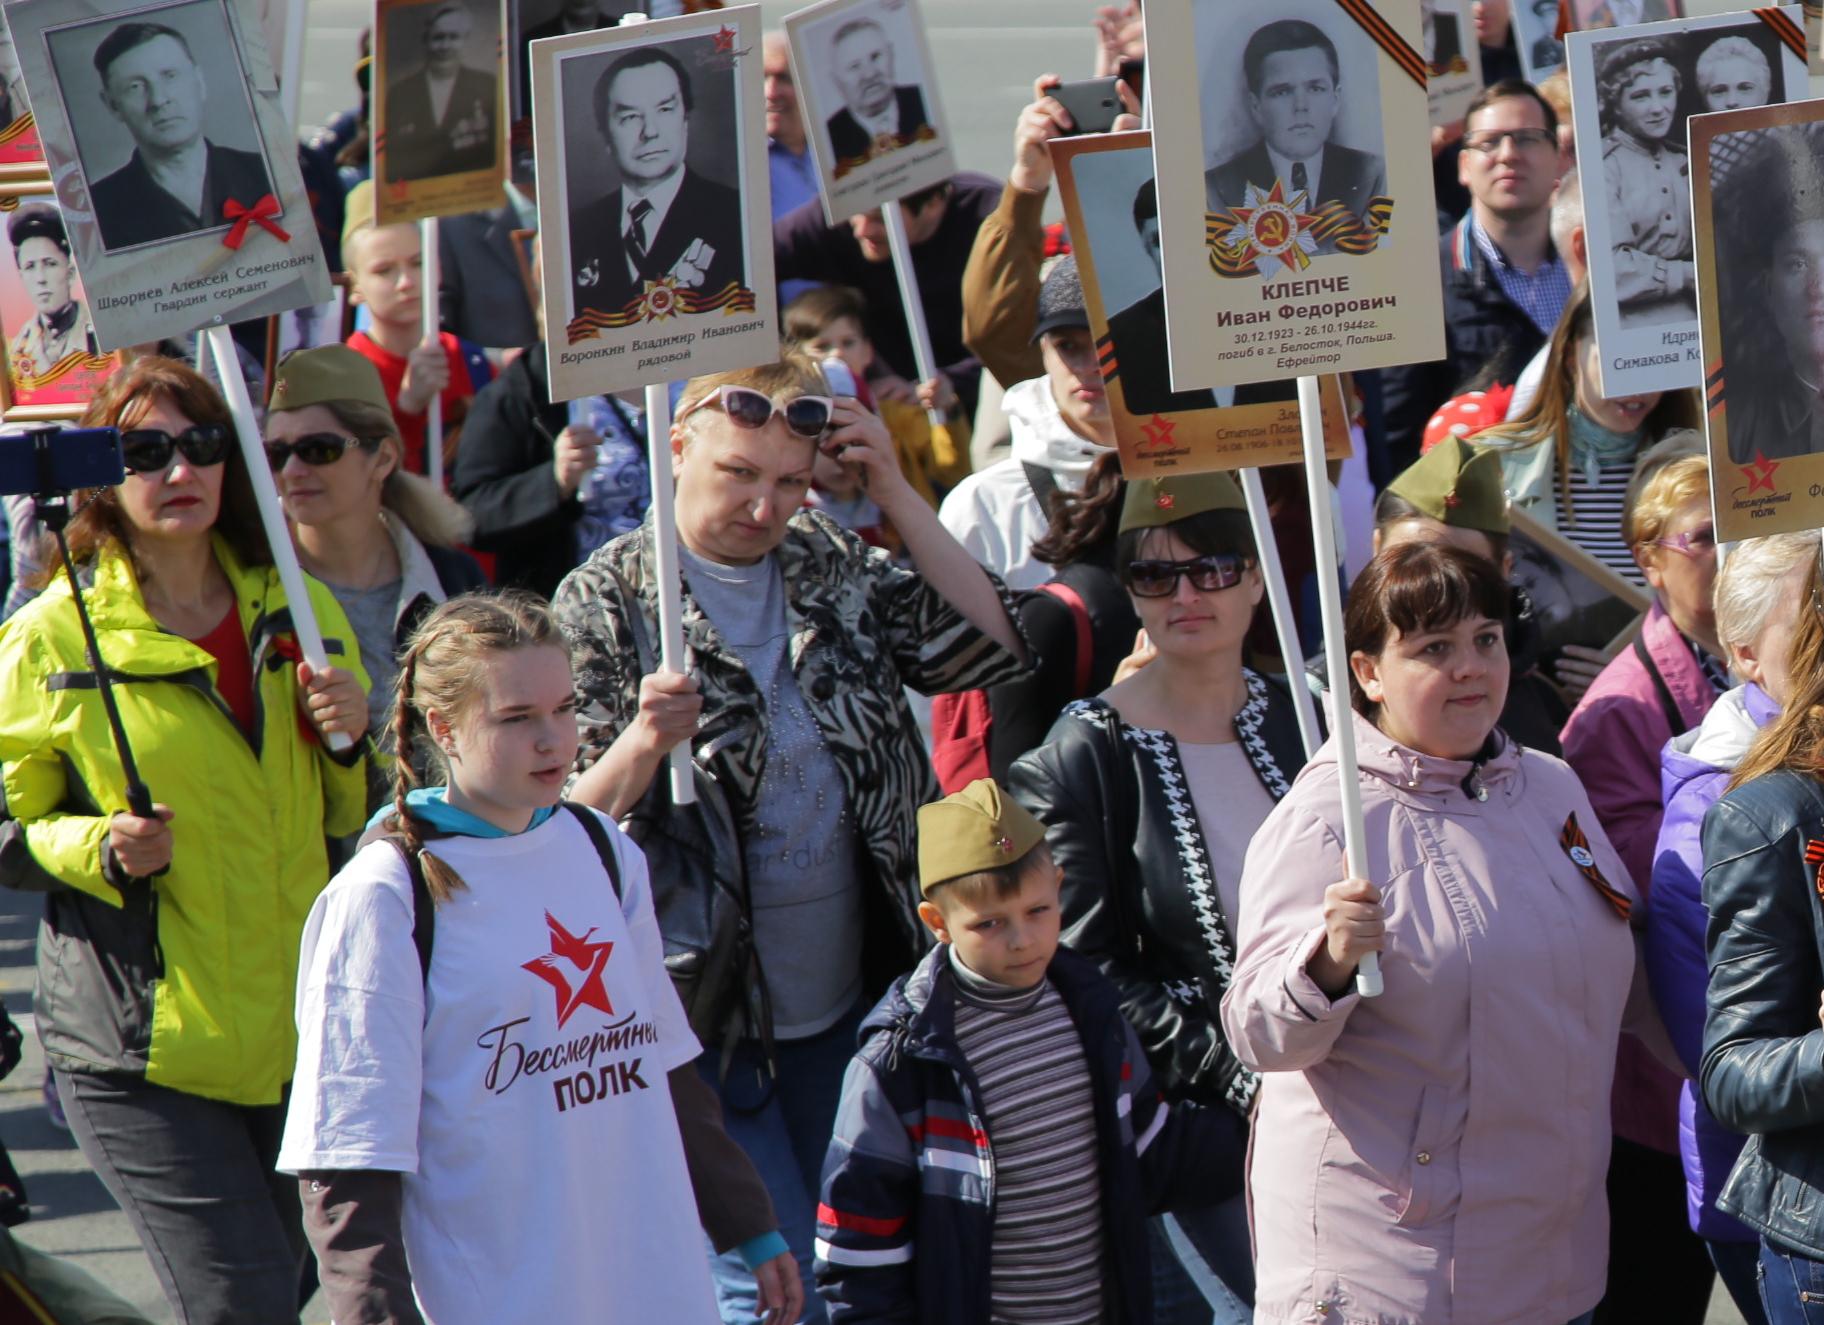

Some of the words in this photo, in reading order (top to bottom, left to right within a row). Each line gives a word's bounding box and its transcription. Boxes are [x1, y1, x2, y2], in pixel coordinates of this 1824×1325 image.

[170, 273, 229, 294] Алексей
[235, 254, 315, 279] Семенович
[213, 279, 268, 300] сержант
[1262, 276, 1350, 300] КЛЕПЧЕ
[1217, 310, 1271, 327] Иван
[1278, 295, 1397, 320] Федорович
[559, 344, 626, 365] Воронкин
[631, 333, 696, 352] Владимир
[701, 319, 765, 340] Иванович
[1234, 328, 1294, 344] 30.12.1923
[1304, 319, 1378, 336] 26.10.1944гг.
[1218, 345, 1254, 361] погиб
[1257, 348, 1264, 356] в
[1267, 347, 1277, 355] г.
[1280, 338, 1343, 353] Белосток,
[1346, 332, 1396, 346] Польша.
[637, 350, 691, 370] рядовой
[1276, 353, 1341, 369] Ефрейтор
[1613, 352, 1680, 370] Симакова
[1216, 427, 1266, 440] Степан
[476, 1010, 658, 1095] Бессмертны
[552, 1057, 649, 1112] ПОЛК
